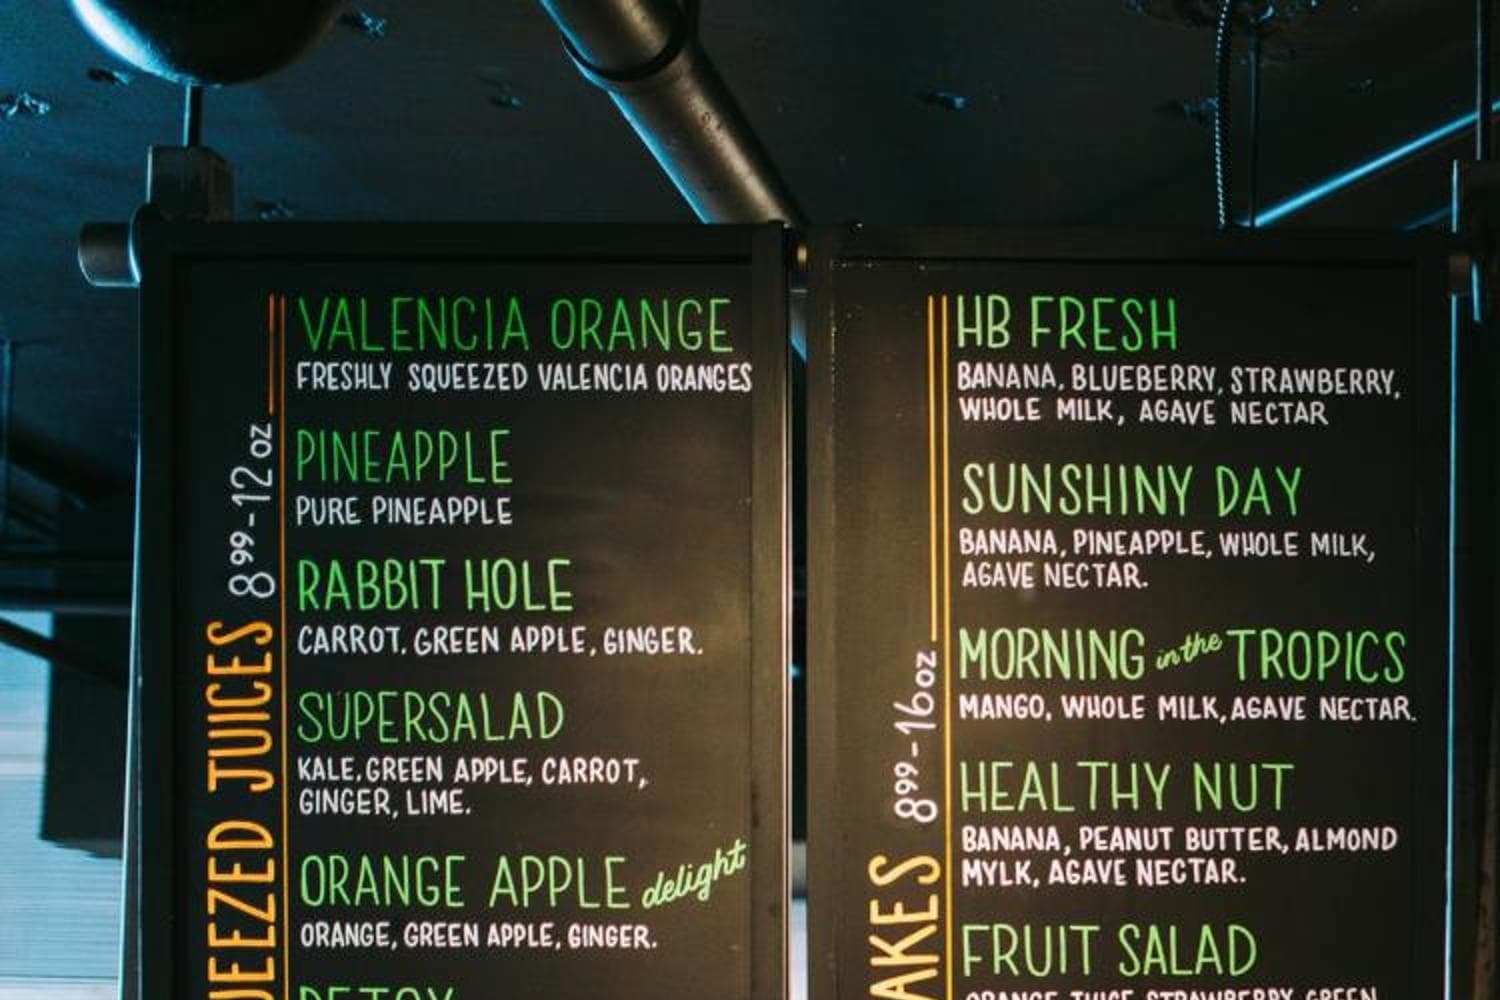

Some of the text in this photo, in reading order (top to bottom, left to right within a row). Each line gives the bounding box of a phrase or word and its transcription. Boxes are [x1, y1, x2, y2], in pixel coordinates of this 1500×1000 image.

[298, 296, 734, 353] VALENCIA ORANGE
[957, 294, 1177, 352] HB FRESH
[296, 361, 753, 393] FRESHLY SQUEEZED VALENCIA ORANGES
[958, 396, 1041, 422] WHOLE
[1139, 398, 1216, 426] AGAVE
[1230, 400, 1329, 425] NECTAR
[297, 429, 513, 484] PINEAPPLE
[295, 495, 513, 526] PURE PINEAPPLE
[961, 462, 1302, 518] SUNSHINY DAY
[298, 557, 573, 613] RABBIT HOLE
[962, 560, 1035, 589] AGAVE
[958, 627, 1145, 681] MORNING
[1225, 628, 1406, 683] TROPICS
[205, 621, 275, 792] JUICES
[297, 690, 565, 743] SUPERSALAD
[406, 788, 471, 816] LIME.
[959, 760, 1295, 813] HEALTHY NUT
[1079, 825, 1174, 852] PEANUT
[1294, 826, 1398, 852] ALMOND
[300, 838, 747, 909] ORANGE APPLE delight
[403, 921, 479, 948] GREEN
[567, 923, 658, 950] GINGER.
[962, 923, 1257, 977] FRUIT SALAD
